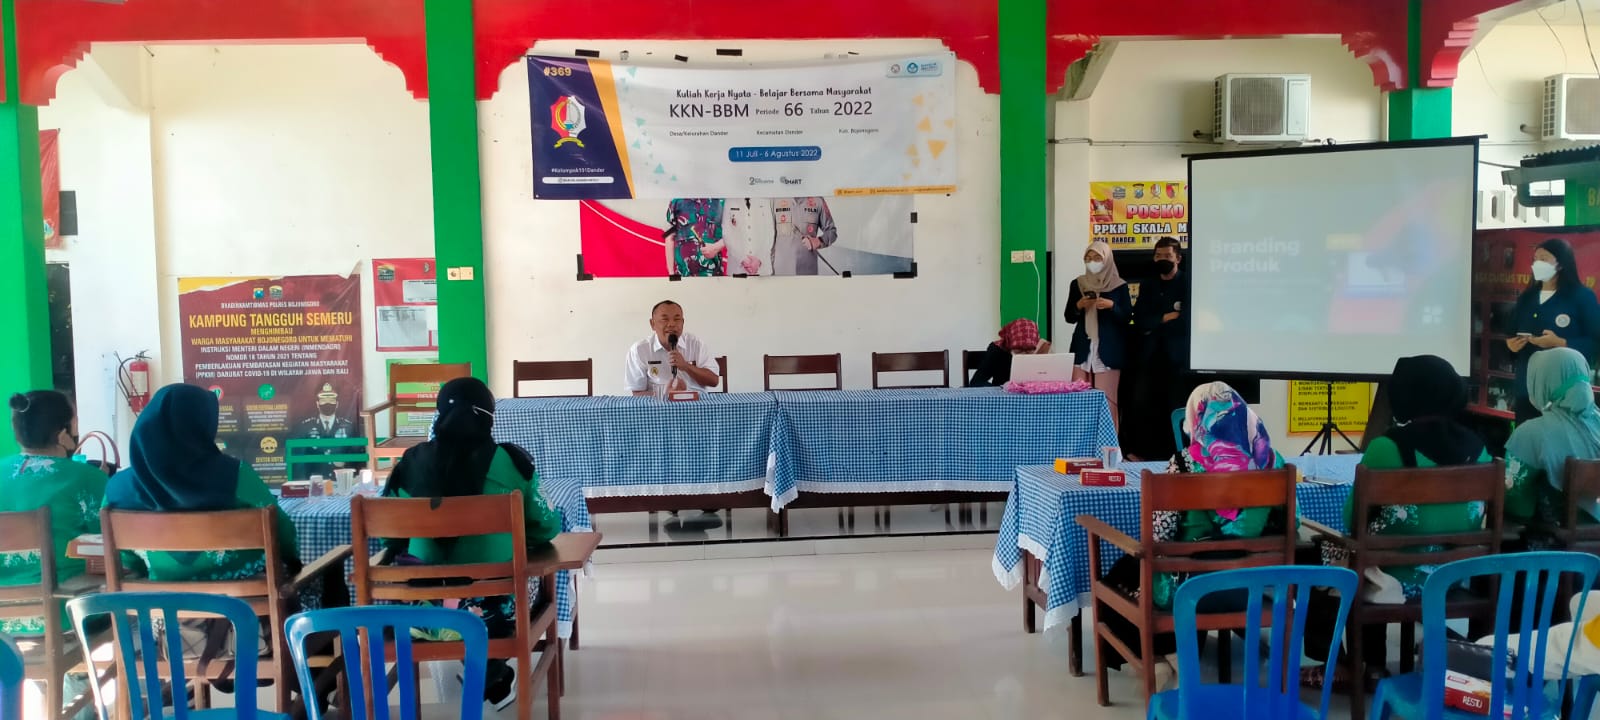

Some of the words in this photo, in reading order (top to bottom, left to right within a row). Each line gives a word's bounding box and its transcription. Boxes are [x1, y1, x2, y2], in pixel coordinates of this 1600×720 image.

[543, 66, 572, 76] #369
[676, 89, 702, 98] Kuliah
[705, 90, 725, 101] Kerja
[728, 90, 751, 100] Nyata
[760, 88, 788, 99] Belajar
[826, 87, 871, 98] Masyarakat
[670, 104, 748, 118] KKN-BBM
[784, 102, 803, 116] 66
[834, 101, 872, 116] 2022
[770, 150, 799, 158] Agustus
[1126, 204, 1184, 219] POSKO
[1093, 223, 1127, 234] PPKM
[1133, 223, 1172, 234] SKALA
[1209, 237, 1300, 256] Branding
[1210, 257, 1280, 272] Produk
[189, 314, 246, 328] KAMPUNG
[249, 313, 303, 327] TANGGUH
[306, 312, 352, 326] SEMERU
[1462, 696, 1483, 708] RESTU
